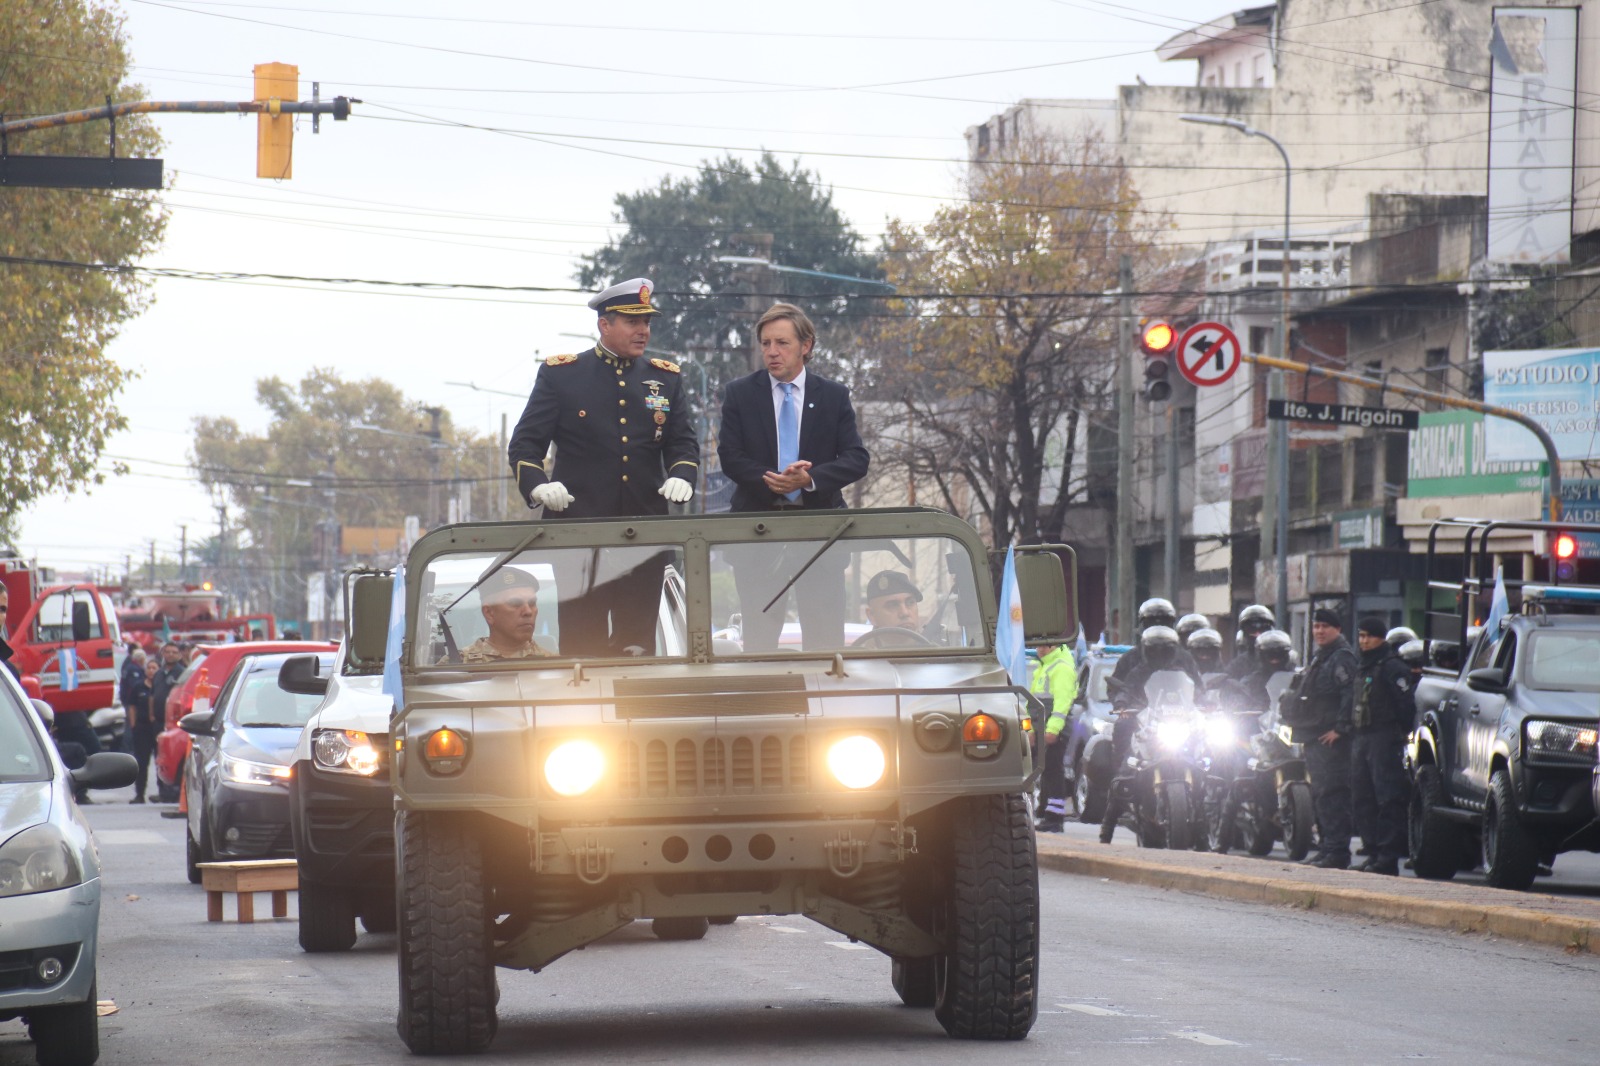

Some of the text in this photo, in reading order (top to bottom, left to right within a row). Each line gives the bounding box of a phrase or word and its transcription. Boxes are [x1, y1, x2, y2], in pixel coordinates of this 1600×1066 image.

[1495, 364, 1588, 385] ESTUDIO
[1318, 405, 1335, 420] J.
[1341, 407, 1404, 427] Irigoin
[1500, 401, 1579, 416] DERISIO
[1408, 423, 1466, 479] FARMACIA
